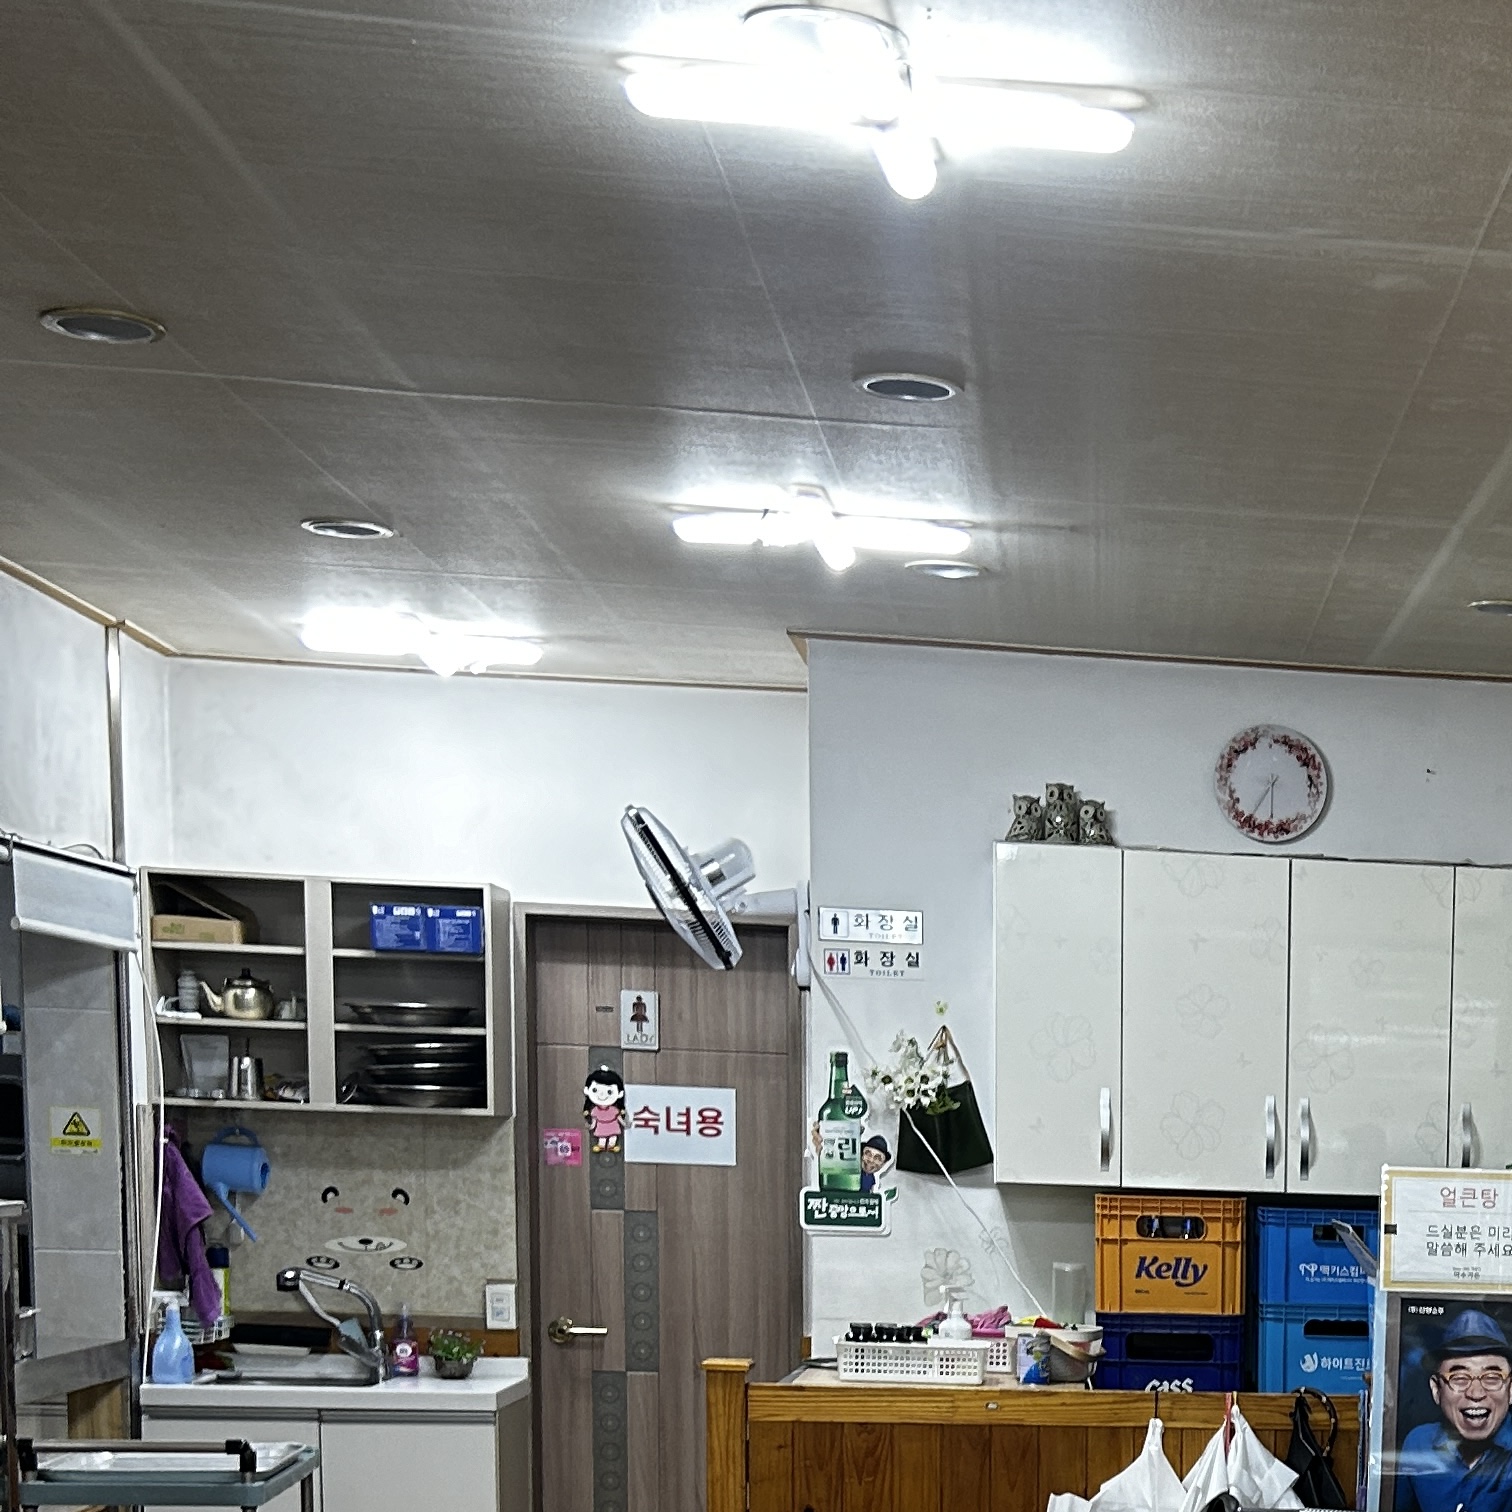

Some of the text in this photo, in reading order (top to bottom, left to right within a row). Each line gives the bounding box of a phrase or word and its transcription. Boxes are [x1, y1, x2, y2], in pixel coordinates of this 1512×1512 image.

[854, 913, 918, 932] 화장실
[854, 950, 920, 968] 화장실
[870, 969, 905, 977] TOILET
[632, 1106, 724, 1138] 숙녀용
[838, 1137, 857, 1161] 린
[1440, 1187, 1499, 1209] 얼큰탕
[1426, 1224, 1482, 1241] 드실분은
[1426, 1241, 1468, 1257] 말씀해
[1135, 1256, 1208, 1287] Kelly
